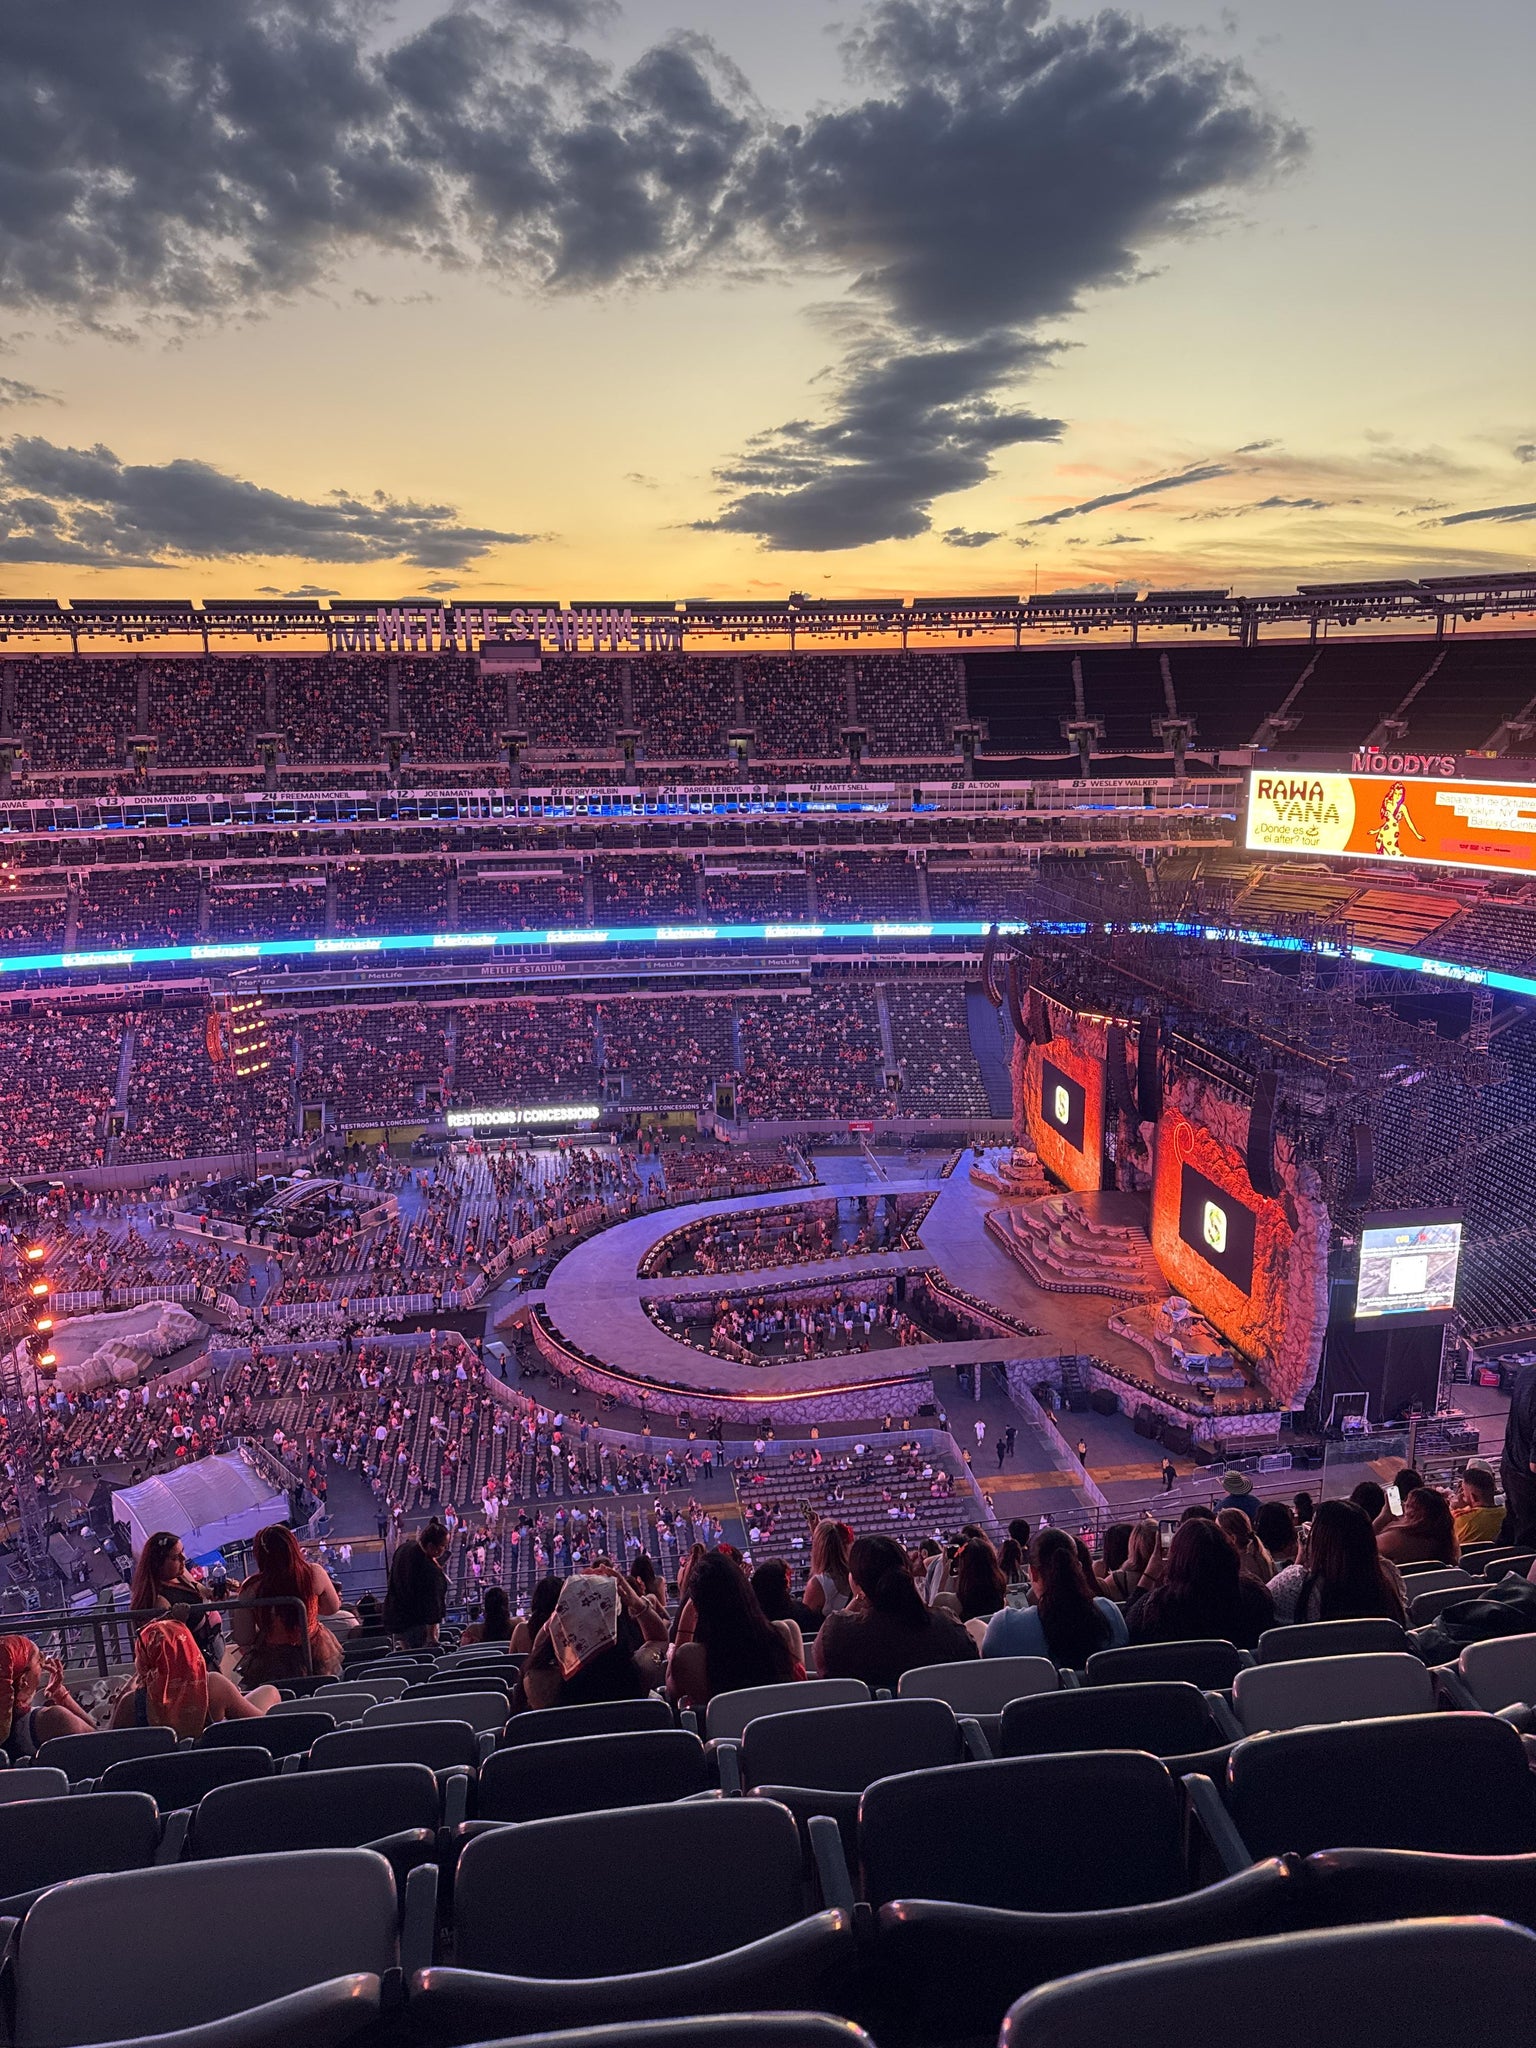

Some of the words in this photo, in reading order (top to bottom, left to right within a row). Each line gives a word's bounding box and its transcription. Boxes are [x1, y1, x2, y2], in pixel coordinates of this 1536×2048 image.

[376, 607, 498, 640] METLIFE
[510, 607, 632, 641] STADIUM
[1351, 753, 1456, 776] MOODY'S
[1072, 780, 1087, 788] 85
[396, 790, 408, 798] 12
[662, 786, 677, 794] 24
[1258, 779, 1324, 801] RAWA
[105, 797, 118, 806] 13
[134, 796, 152, 804] DON
[154, 796, 196, 804] MAYNARD
[262, 792, 278, 800] 24
[280, 792, 320, 800] FREEMAN
[0, 801, 28, 809] AWAE
[1273, 801, 1340, 824] YANA
[1274, 835, 1300, 844] after?
[1302, 836, 1320, 846] tour
[481, 966, 520, 974] METLIFE
[524, 964, 566, 973] STADIUM
[368, 972, 403, 980] MetLife
[617, 1105, 650, 1113] RESTROOMS
[659, 1104, 700, 1112] CONCESSIONS
[448, 1111, 516, 1127] RESTROOMS
[517, 1110, 522, 1124] /
[523, 1106, 600, 1124] CONCESSIONS
[340, 1121, 376, 1130] RESTROOMS
[384, 1118, 430, 1127] CONCESSIONS
